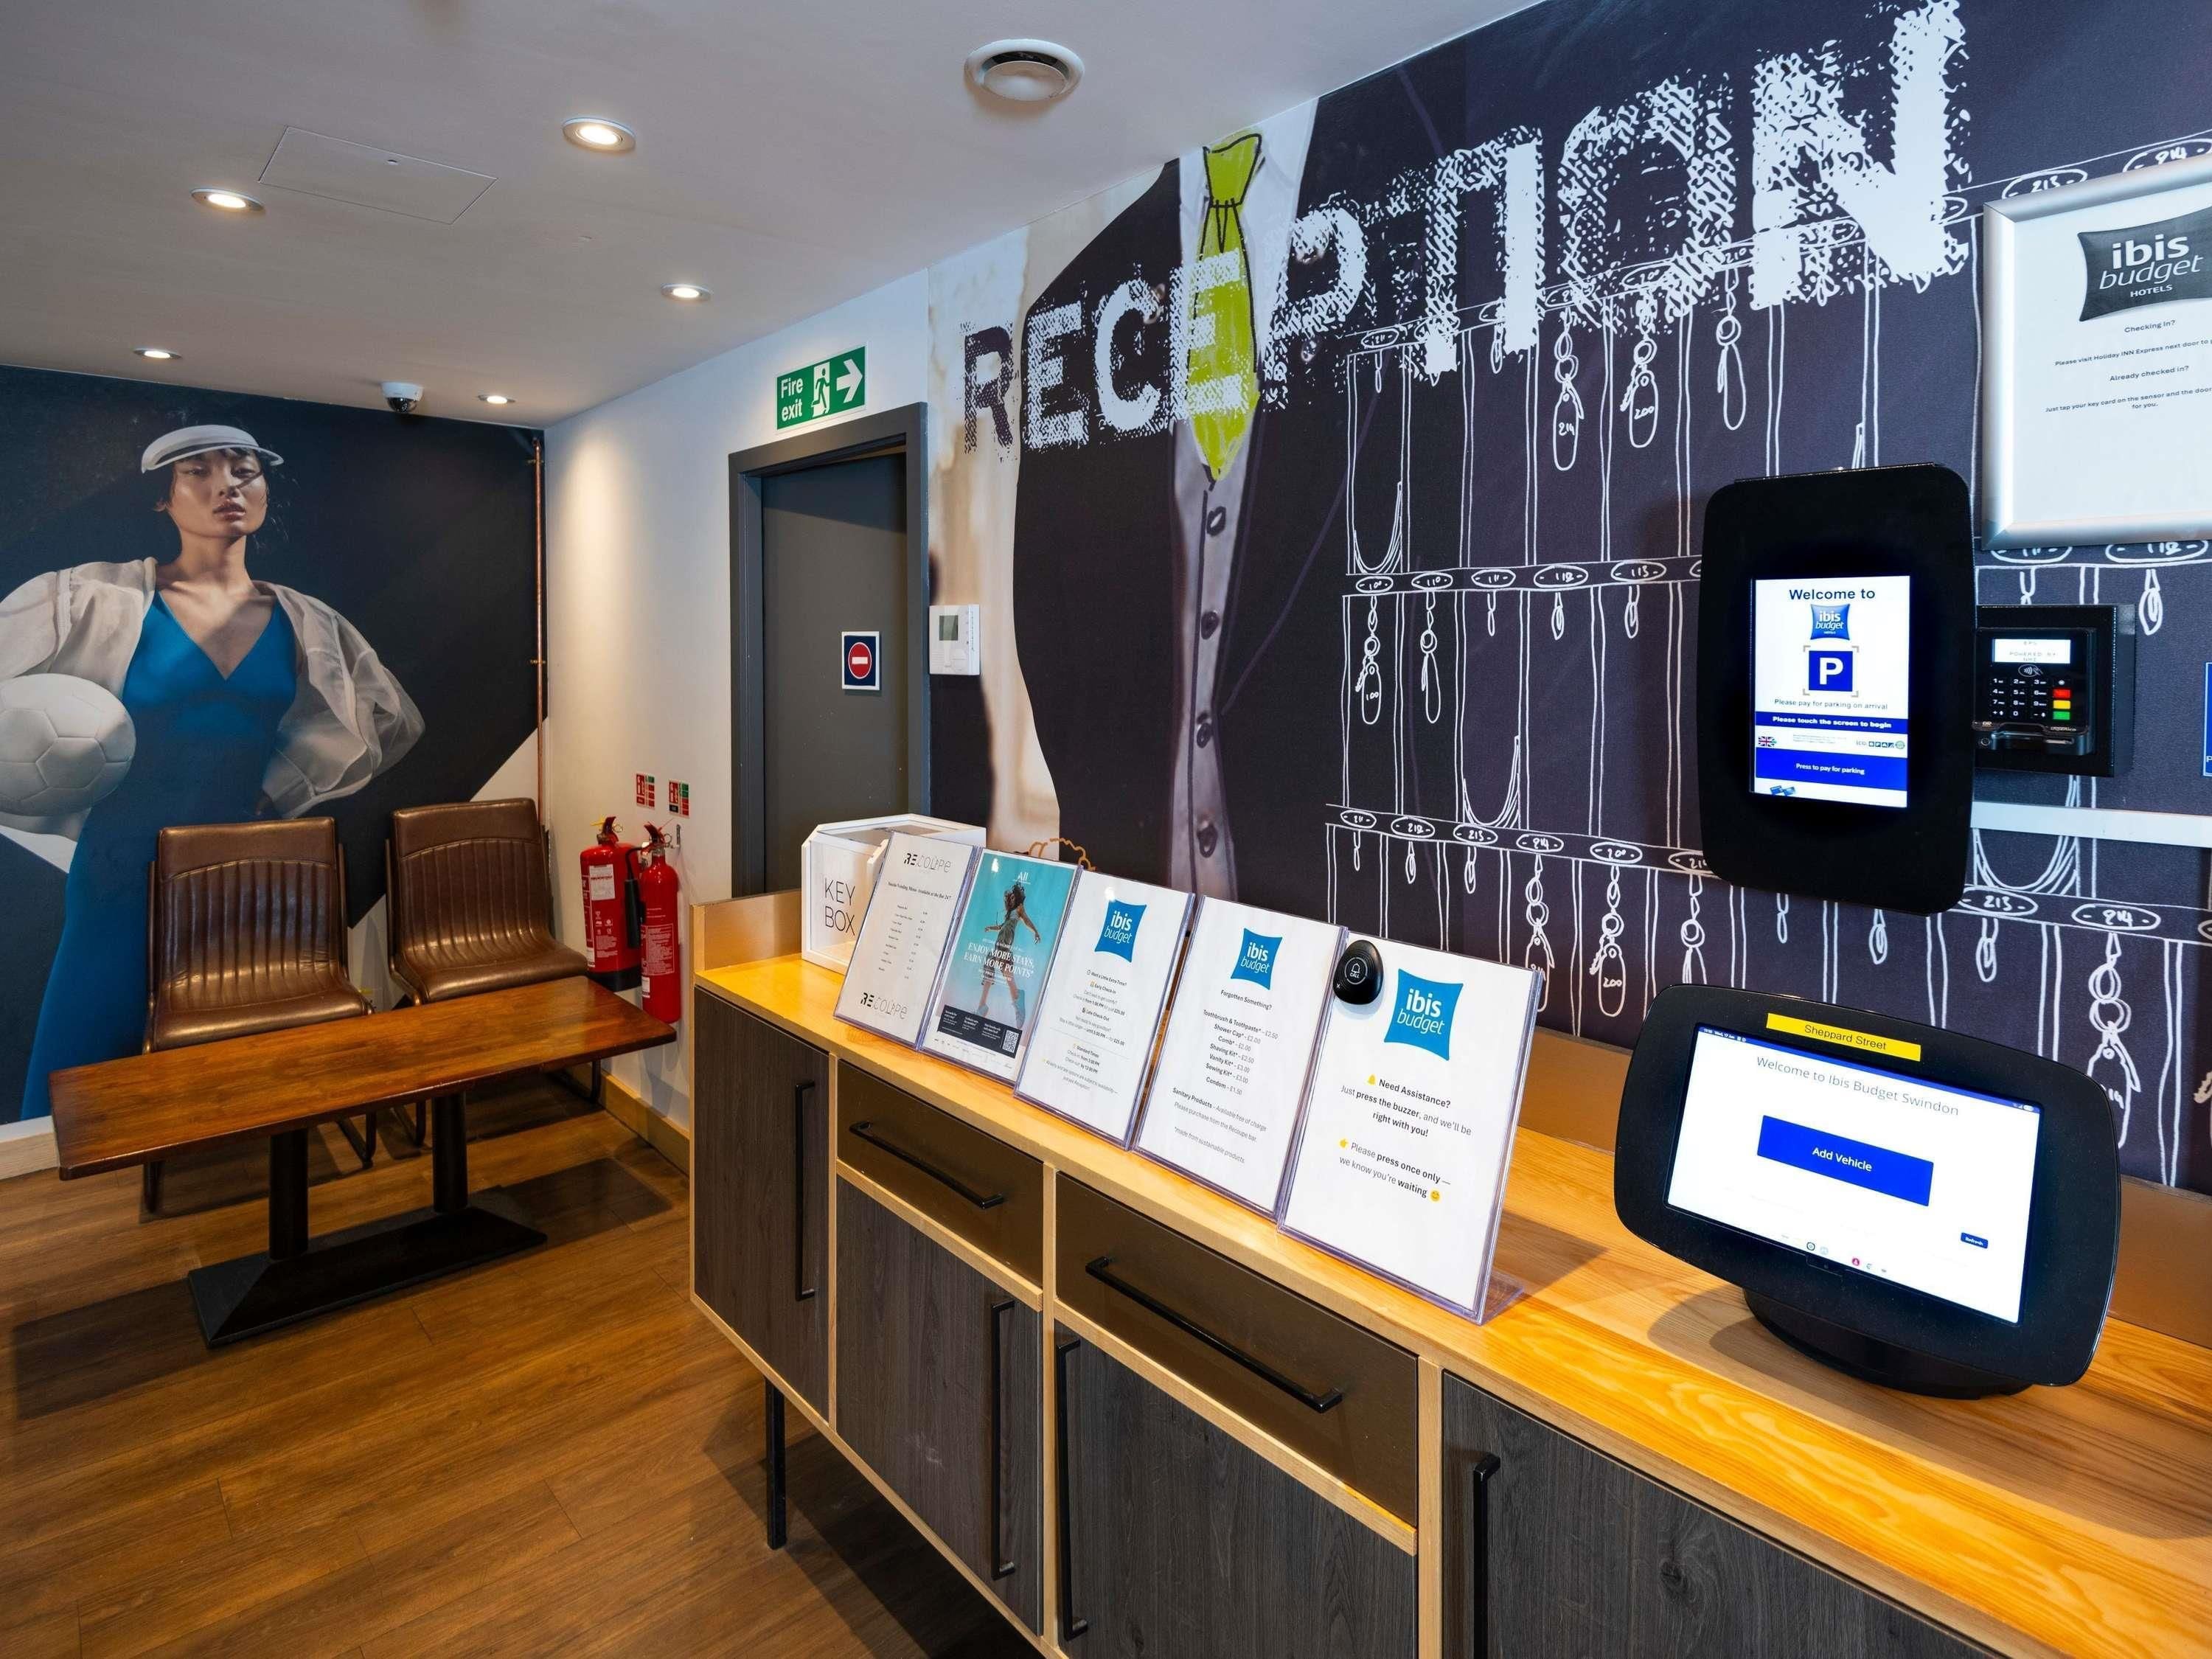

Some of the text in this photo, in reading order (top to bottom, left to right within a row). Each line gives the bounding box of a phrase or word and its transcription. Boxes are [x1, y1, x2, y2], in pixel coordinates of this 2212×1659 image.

[960, 0, 1970, 463] RECEPTION
[2112, 234, 2190, 269] ibis
[2099, 254, 2204, 290] budget
[2130, 284, 2173, 298] HOTELS
[2124, 321, 2162, 333] Checking
[2094, 352, 2119, 361] Holiday
[2136, 346, 2163, 355] Express
[2110, 373, 2139, 381] Already
[2141, 367, 2175, 377] checked
[781, 378, 804, 399] Fire
[782, 398, 803, 422] exit
[2072, 403, 2086, 411] your
[2140, 392, 2165, 400] sensor
[1634, 405, 1657, 420] 200
[1559, 422, 1575, 437] 214
[1789, 588, 1876, 600] Welcome to
[1815, 621, 1845, 631] budget
[1819, 611, 1841, 622] ibis
[1819, 656, 1844, 686] P
[1366, 691, 1380, 700] 100
[1824, 701, 1851, 709] parking
[1798, 717, 1818, 725] touch
[1869, 721, 1892, 729] begin
[1796, 762, 1812, 771] Press
[1842, 767, 1865, 776] parking
[1468, 830, 1485, 842] 213
[824, 878, 855, 906] KEY
[1983, 894, 2012, 911] 213
[824, 905, 855, 936] BOX
[1110, 911, 1133, 932] ibis
[1104, 925, 1133, 945] budget
[964, 951, 984, 964] EARN
[984, 957, 1004, 971] MORE
[968, 942, 990, 956] ENJOY
[990, 948, 1012, 961] MORE
[1247, 942, 1269, 961] ibis
[1240, 956, 1270, 974] budget
[1603, 977, 1622, 988] 200
[1221, 989, 1273, 1011] Forgotten Something?
[1405, 988, 1442, 1018] ibis
[1203, 1009, 1228, 1023] Toothbrush
[1265, 1030, 1279, 1040] £2.50
[1397, 1008, 1445, 1035] budget
[1214, 1023, 1232, 1034] Shower
[1247, 1035, 1262, 1045] £2.00
[1804, 1023, 1887, 1050] Sheppard Street
[1209, 1043, 1228, 1056] Shaving
[1241, 1054, 1255, 1064] £2.50
[1238, 1043, 1251, 1052] £2.00
[1206, 1062, 1223, 1075] Sewing
[1209, 1053, 1224, 1064] Vanity
[1206, 1077, 1242, 1096] Condom £1.50
[1379, 1078, 1451, 1109] Need Assistance?
[1757, 1056, 1959, 1116] Welcome to Ibis Budget Swindon
[1172, 1087, 1192, 1101] Sanitary
[1191, 1095, 1213, 1109] Products
[1216, 1105, 1237, 1119] Available
[1237, 1113, 1245, 1123] free
[1340, 1085, 1472, 1136] Just press the buzzer, and we'll be
[1174, 1101, 1189, 1113] Please
[1188, 1108, 1210, 1122] purchase
[1208, 1116, 1220, 1126] from
[1220, 1121, 1229, 1130] the
[1228, 1125, 1248, 1140] Recoupe
[1372, 1111, 1429, 1138] right with you!
[1188, 1133, 1199, 1142] from
[1198, 1138, 1225, 1154] sustainable
[1351, 1141, 1441, 1185] Please press once only
[1812, 1147, 1873, 1172] Add Vehicle
[1339, 1156, 1427, 1199] we know you're waiting
